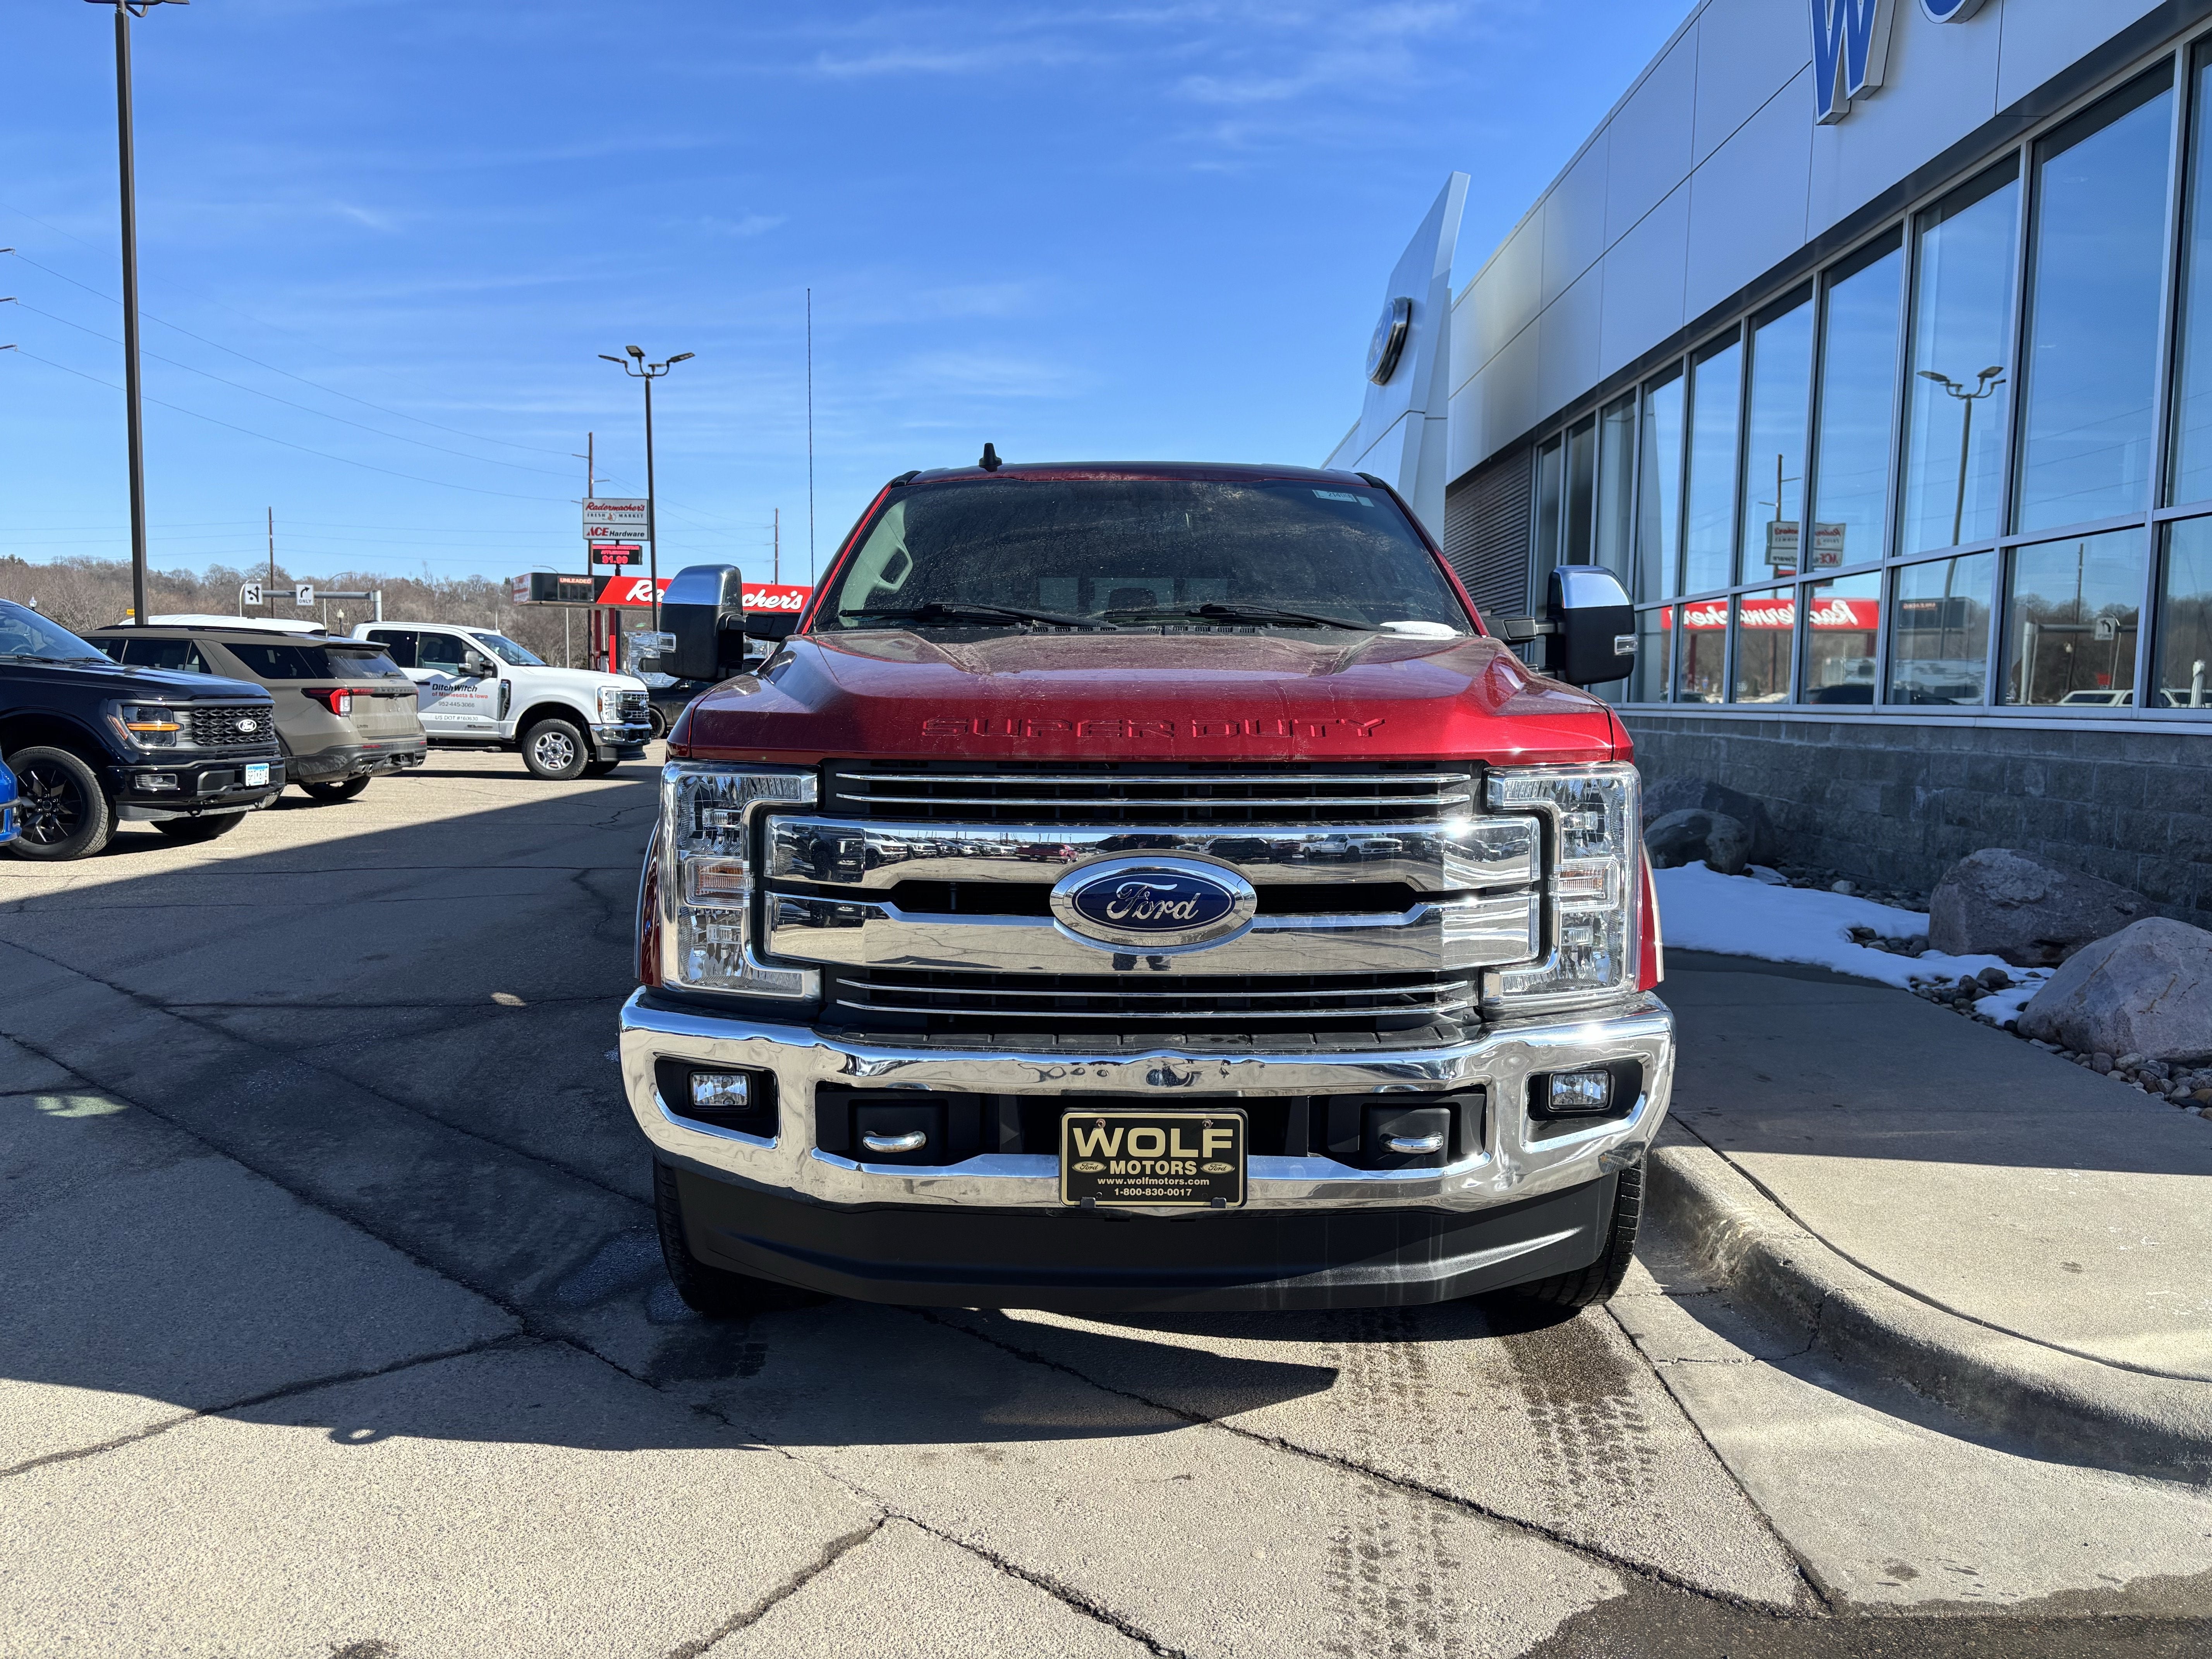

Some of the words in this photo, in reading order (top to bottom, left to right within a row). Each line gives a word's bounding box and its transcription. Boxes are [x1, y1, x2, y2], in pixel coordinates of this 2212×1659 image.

[586, 502, 645, 511] Radermacher's
[586, 526, 609, 536] ACE
[921, 718, 1175, 737] SUPER
[1192, 718, 1386, 737] DUTY
[1106, 881, 1201, 920] Ford
[1073, 1127, 1233, 1158] WOLF
[1080, 1163, 1099, 1171] Ford
[1110, 1160, 1197, 1175] MOTORS
[1208, 1163, 1227, 1171] Ford
[1097, 1177, 1210, 1185] www.wolfmotors.com
[1114, 1188, 1192, 1196] 1-800-830-0017
